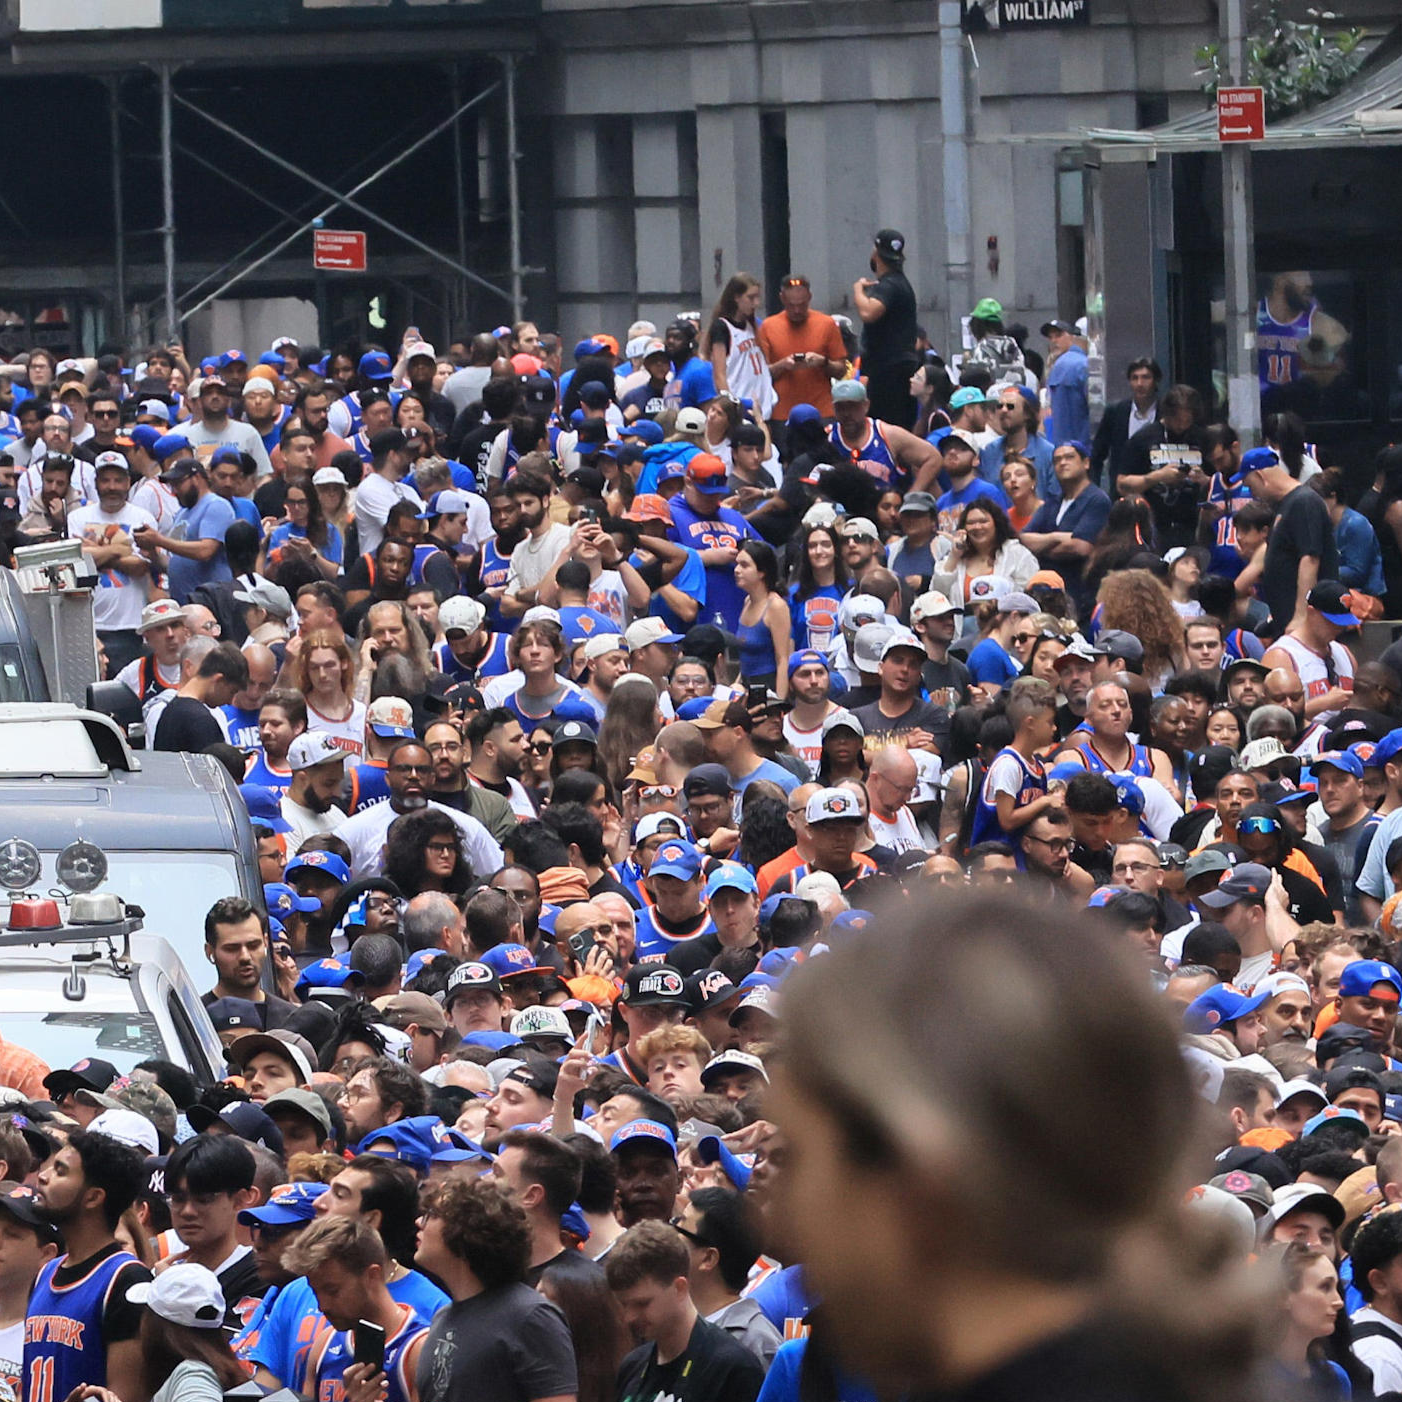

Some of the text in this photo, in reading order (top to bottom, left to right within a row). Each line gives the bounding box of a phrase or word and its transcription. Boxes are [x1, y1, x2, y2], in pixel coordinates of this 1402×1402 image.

[1005, 1, 1073, 20] WILLIAM
[1268, 355, 1291, 382] 11
[237, 727, 260, 747] NE
[639, 976, 661, 994] FINALS
[513, 1010, 559, 1032] YANKEES
[528, 1021, 541, 1032] NY
[148, 1168, 166, 1194] NY
[48, 1317, 86, 1350] YORK
